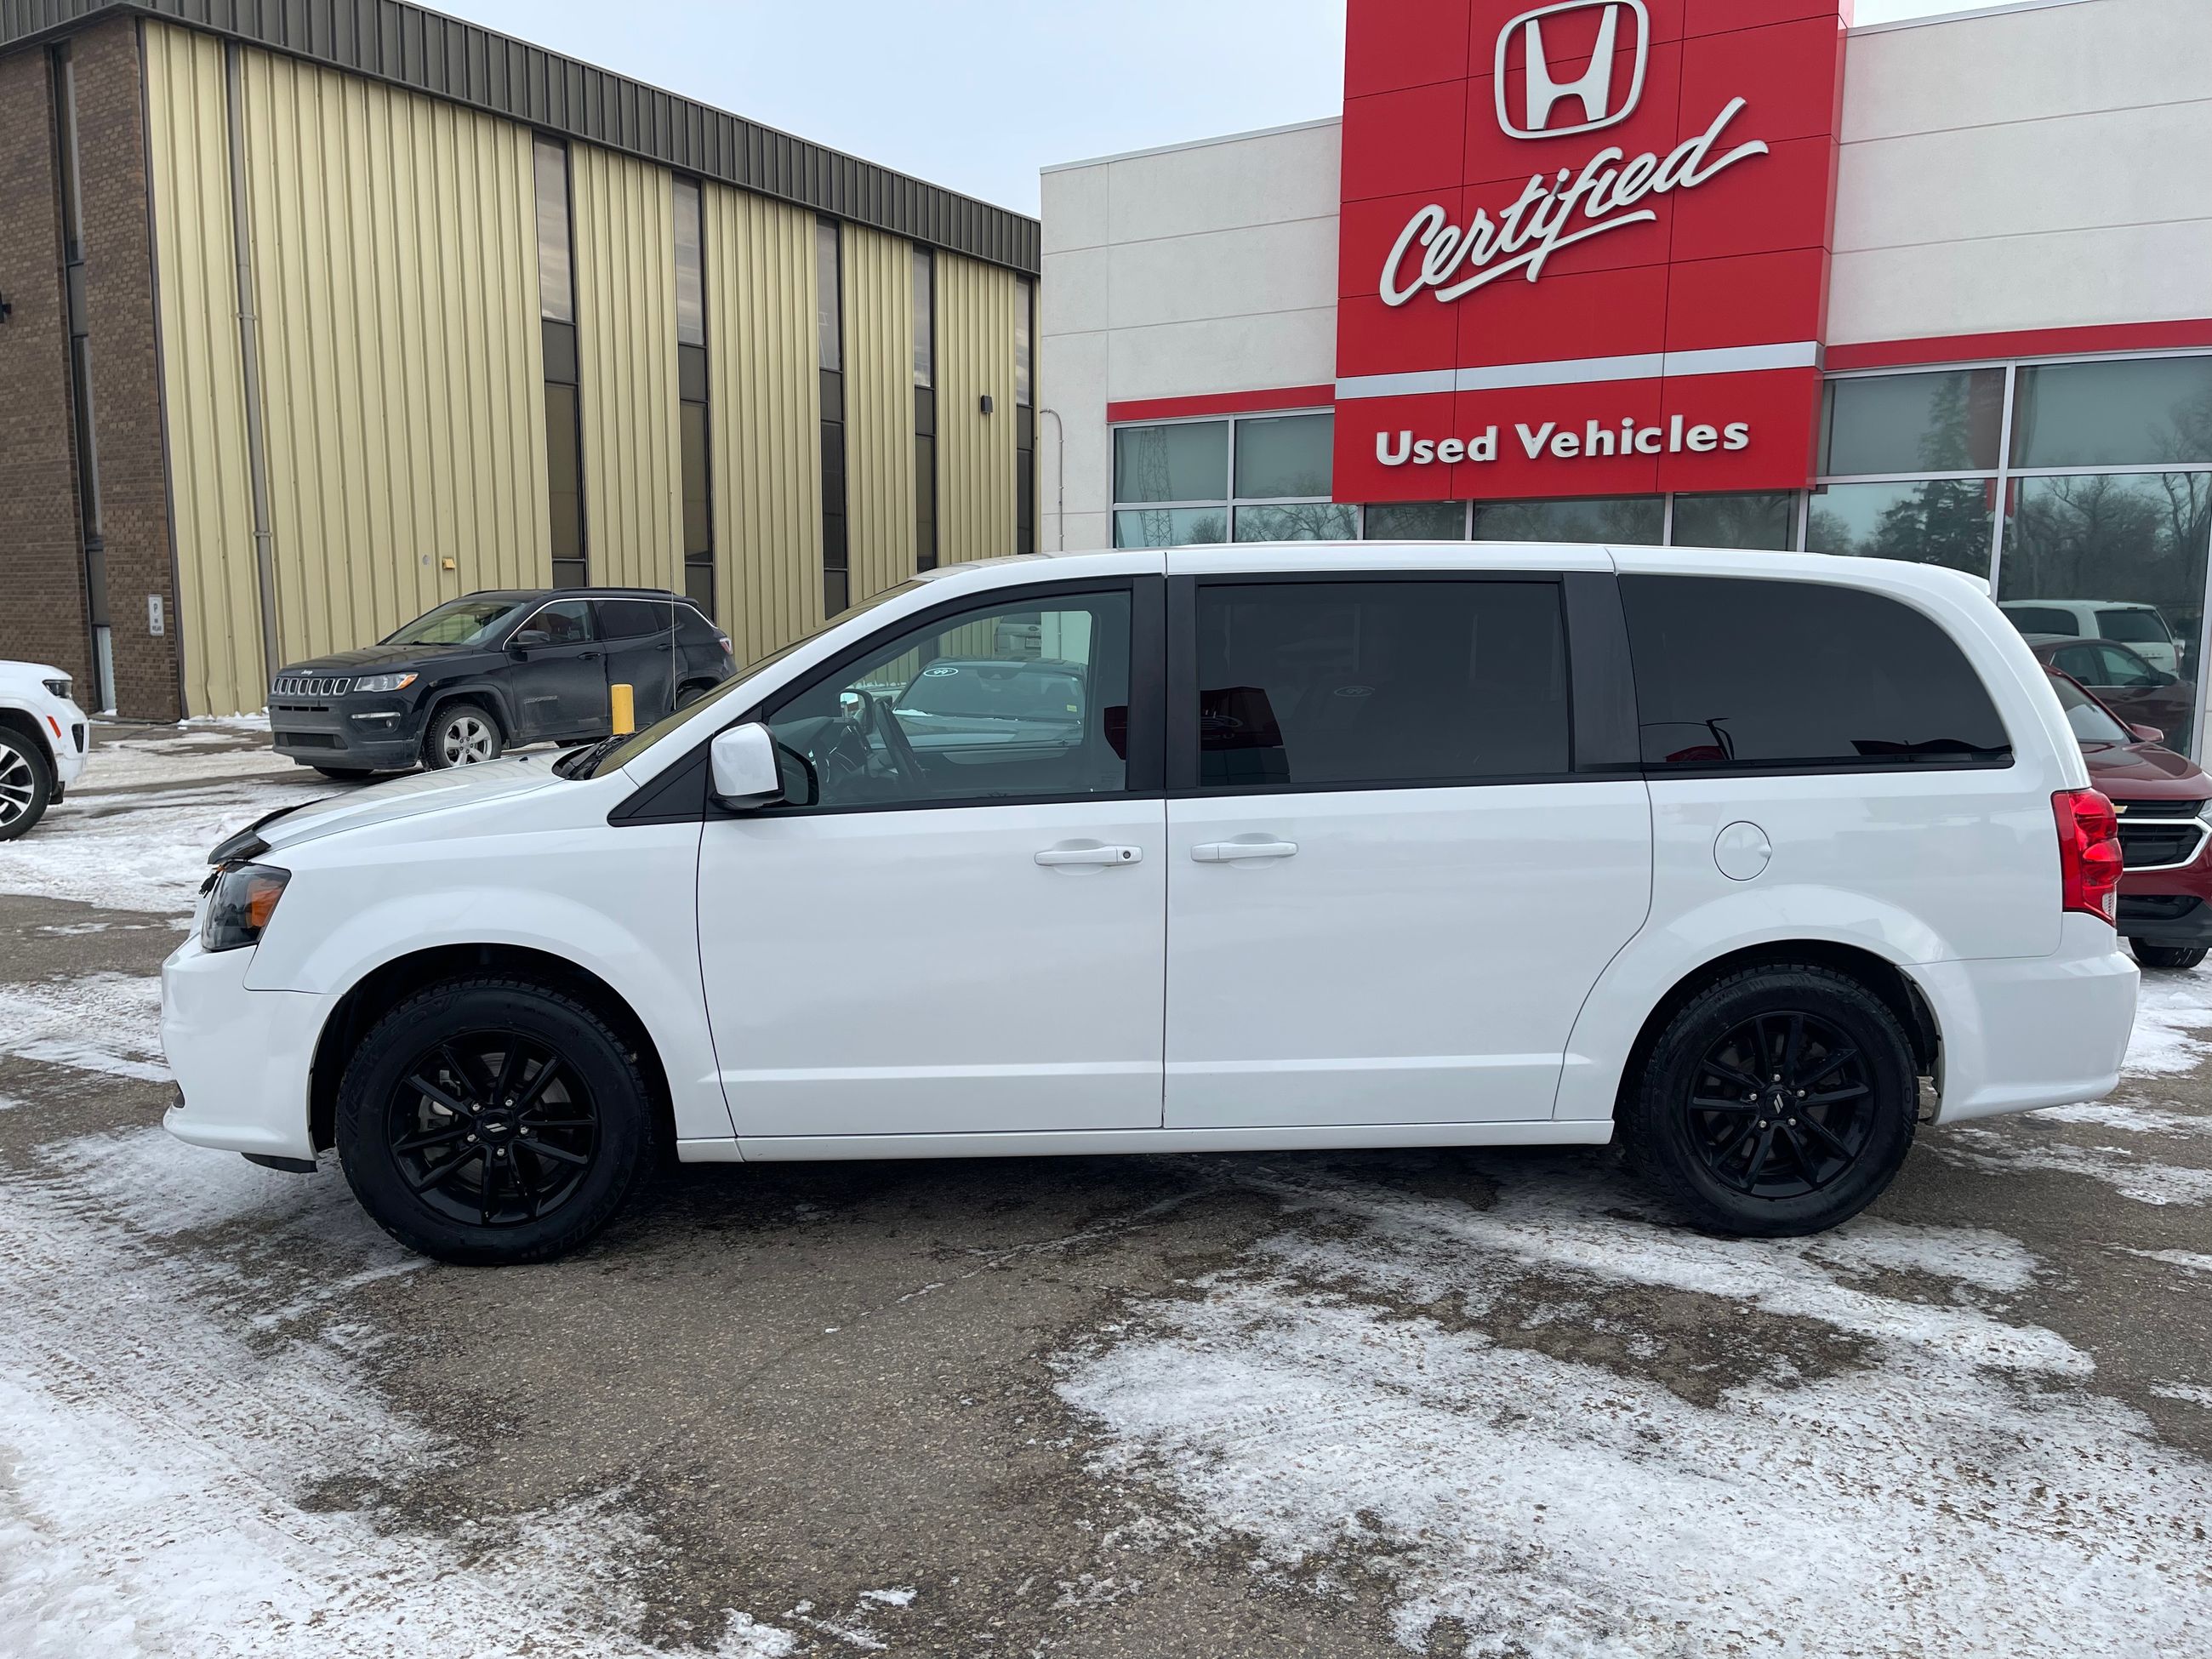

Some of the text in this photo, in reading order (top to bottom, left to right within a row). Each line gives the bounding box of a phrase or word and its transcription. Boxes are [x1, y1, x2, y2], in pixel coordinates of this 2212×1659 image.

[1379, 96, 1769, 307] Certified
[1376, 414, 1749, 466] Used Vehicles
